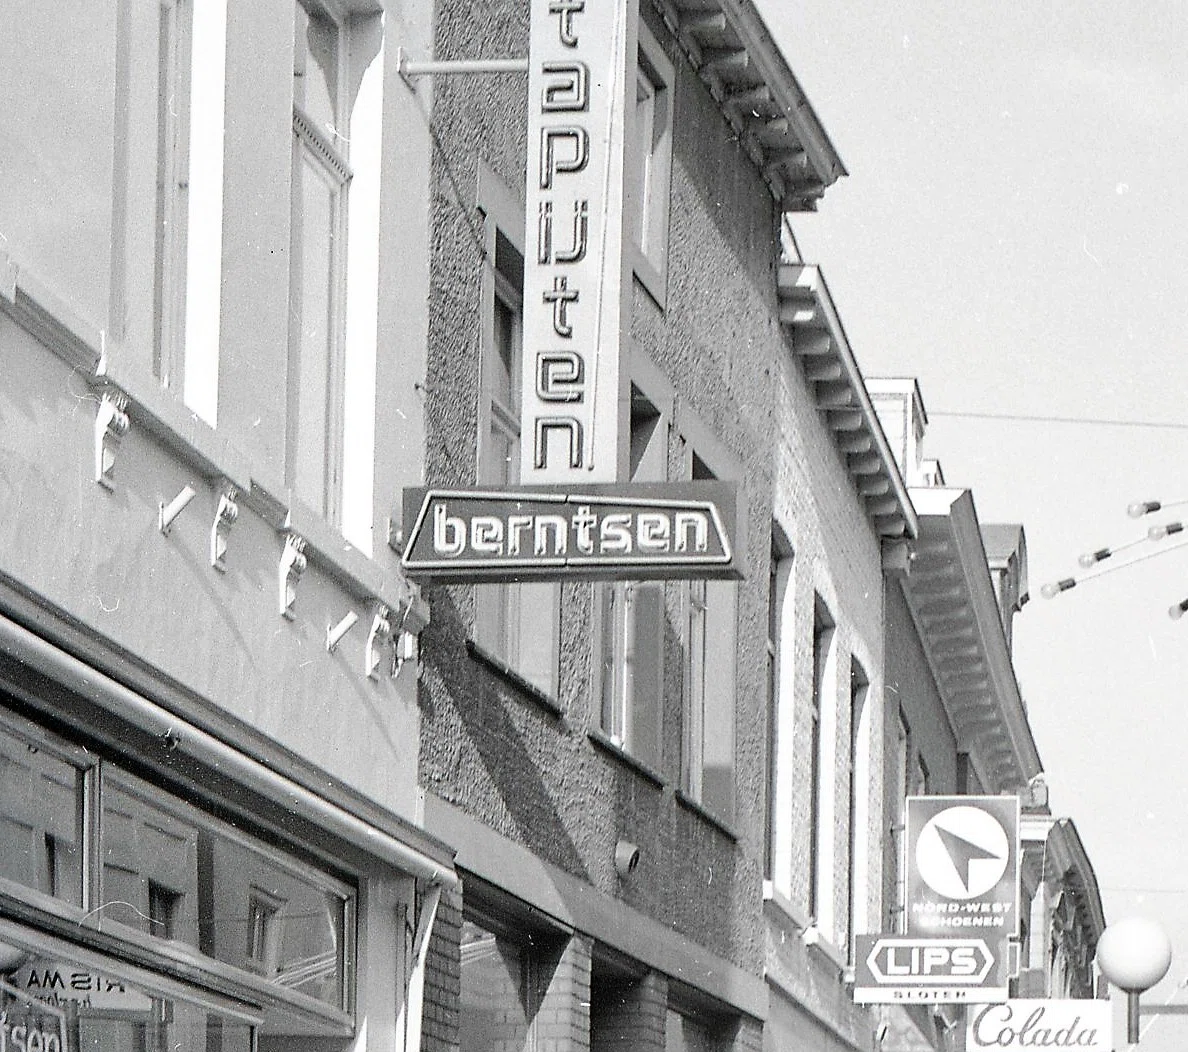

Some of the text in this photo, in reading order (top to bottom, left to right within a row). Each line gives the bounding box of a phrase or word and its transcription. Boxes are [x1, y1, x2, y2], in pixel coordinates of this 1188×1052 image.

[433, 503, 709, 557] berntsen
[912, 902, 1013, 913] NORD-WEST
[887, 947, 977, 975] LIPS
[972, 1003, 1099, 1048] Colada
